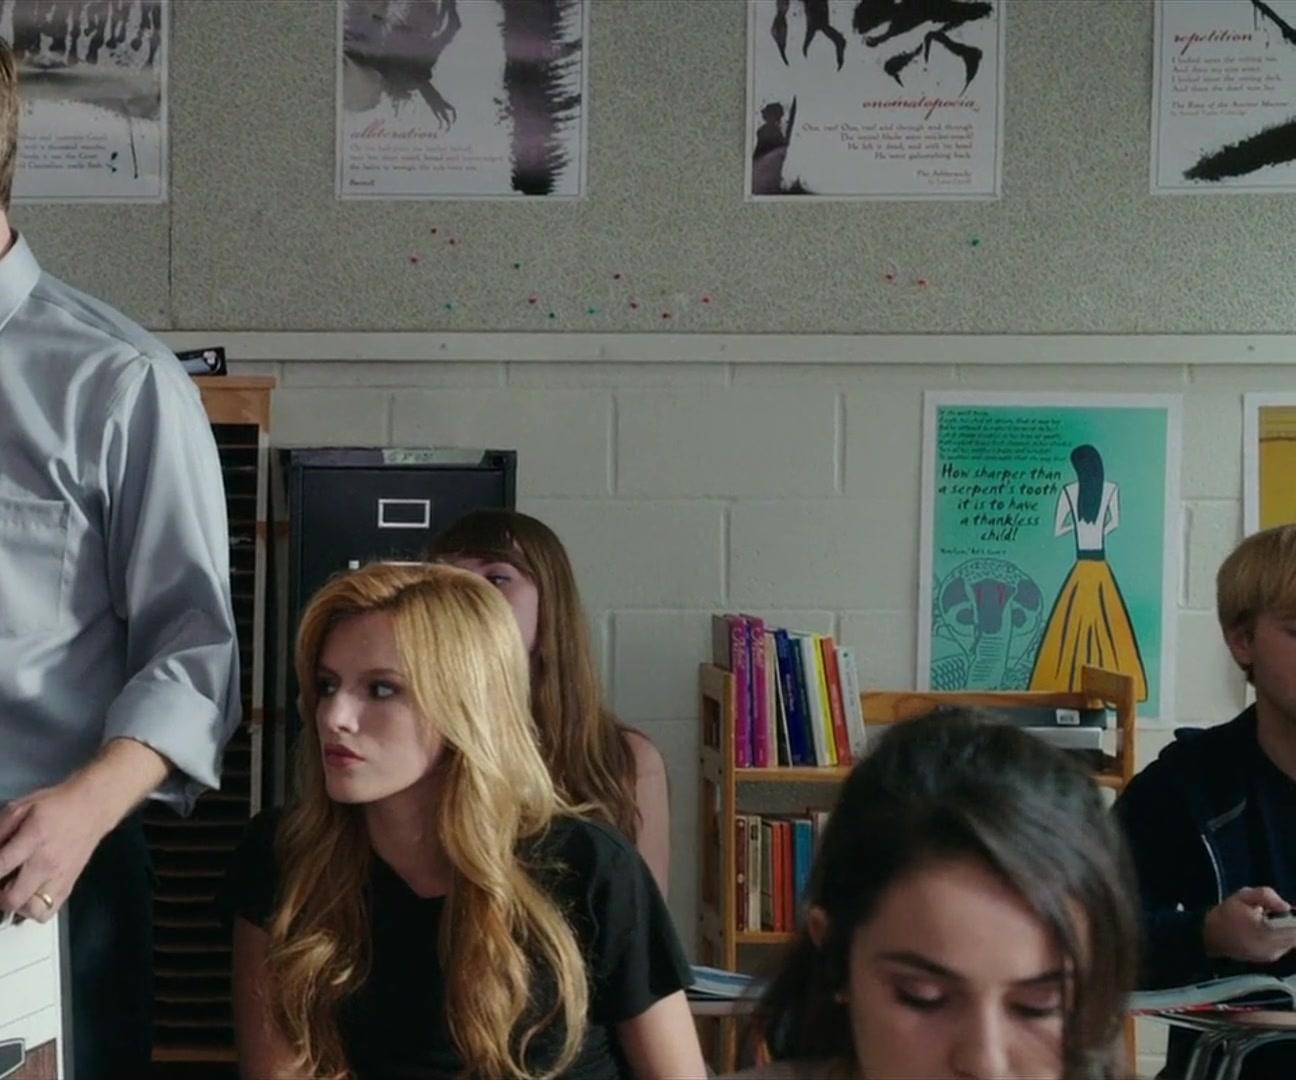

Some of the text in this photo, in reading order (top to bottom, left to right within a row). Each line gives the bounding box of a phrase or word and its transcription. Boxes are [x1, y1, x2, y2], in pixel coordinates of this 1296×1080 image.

[941, 462, 1062, 481] How sharper than
[938, 480, 1058, 497] a serpent's tooth
[957, 497, 1039, 511] it is to have
[959, 513, 1040, 526] a thankless
[980, 527, 1019, 541] child!
